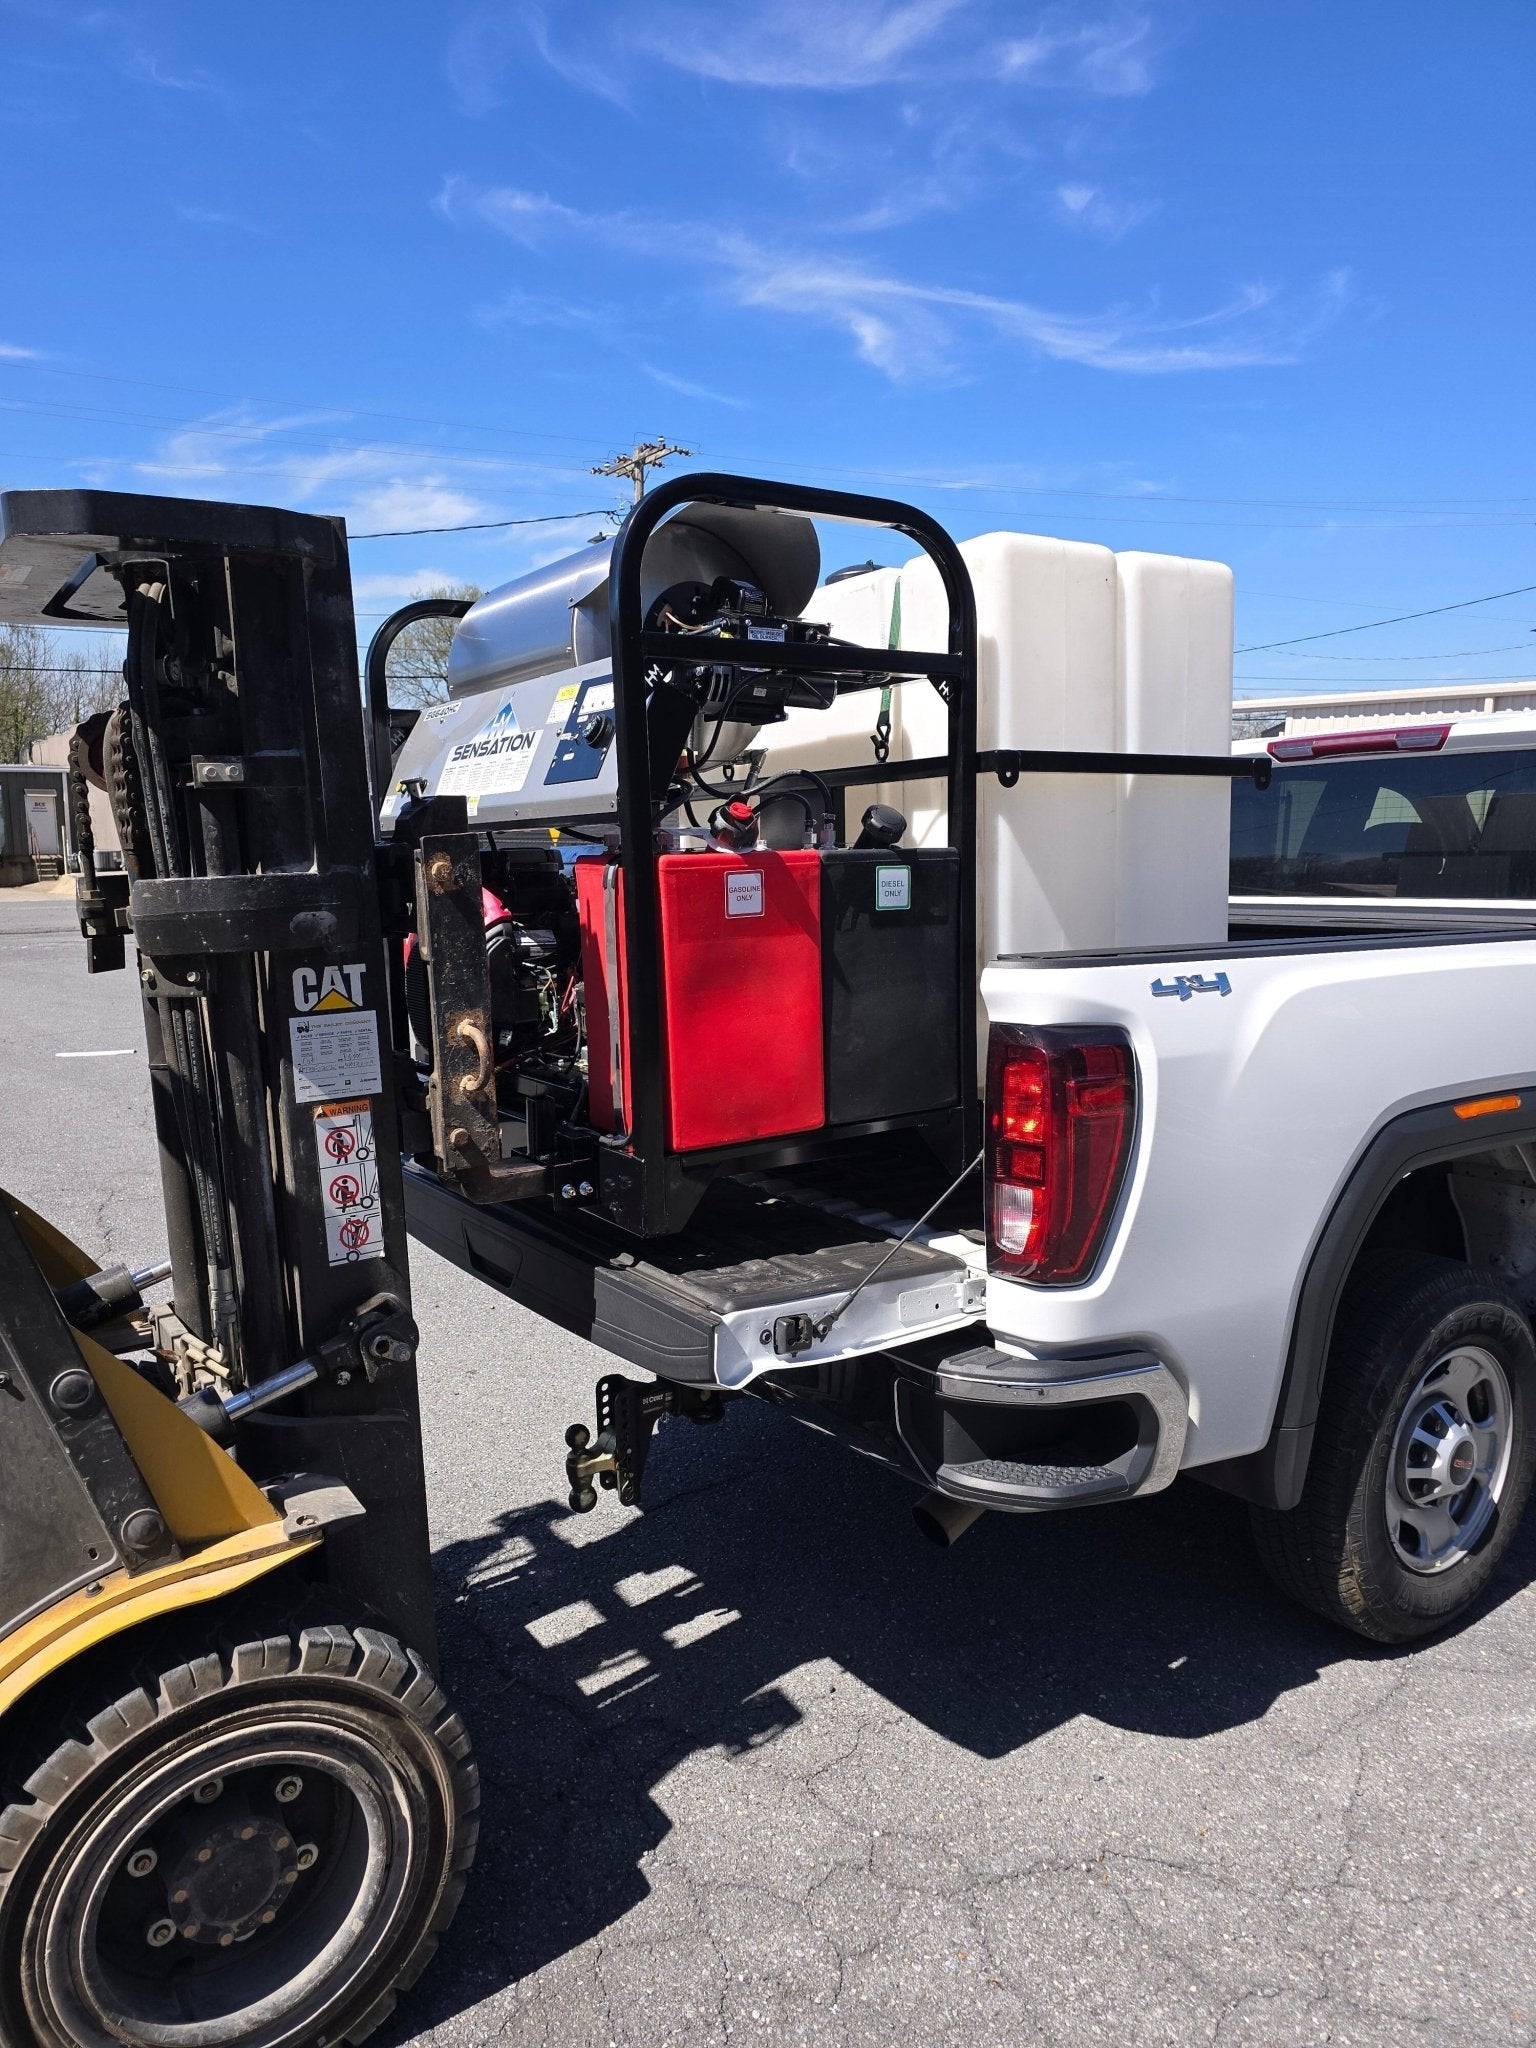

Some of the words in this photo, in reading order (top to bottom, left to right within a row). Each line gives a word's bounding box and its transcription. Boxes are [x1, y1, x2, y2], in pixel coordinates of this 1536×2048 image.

[452, 732, 536, 762] SENSATION
[881, 880, 905, 888] DIESEL
[728, 885, 761, 893] GASOLINE
[884, 889, 902, 898] ONLY
[736, 894, 753, 902] ONLY
[292, 963, 367, 1012] CAT
[330, 1103, 369, 1116] WARNING
